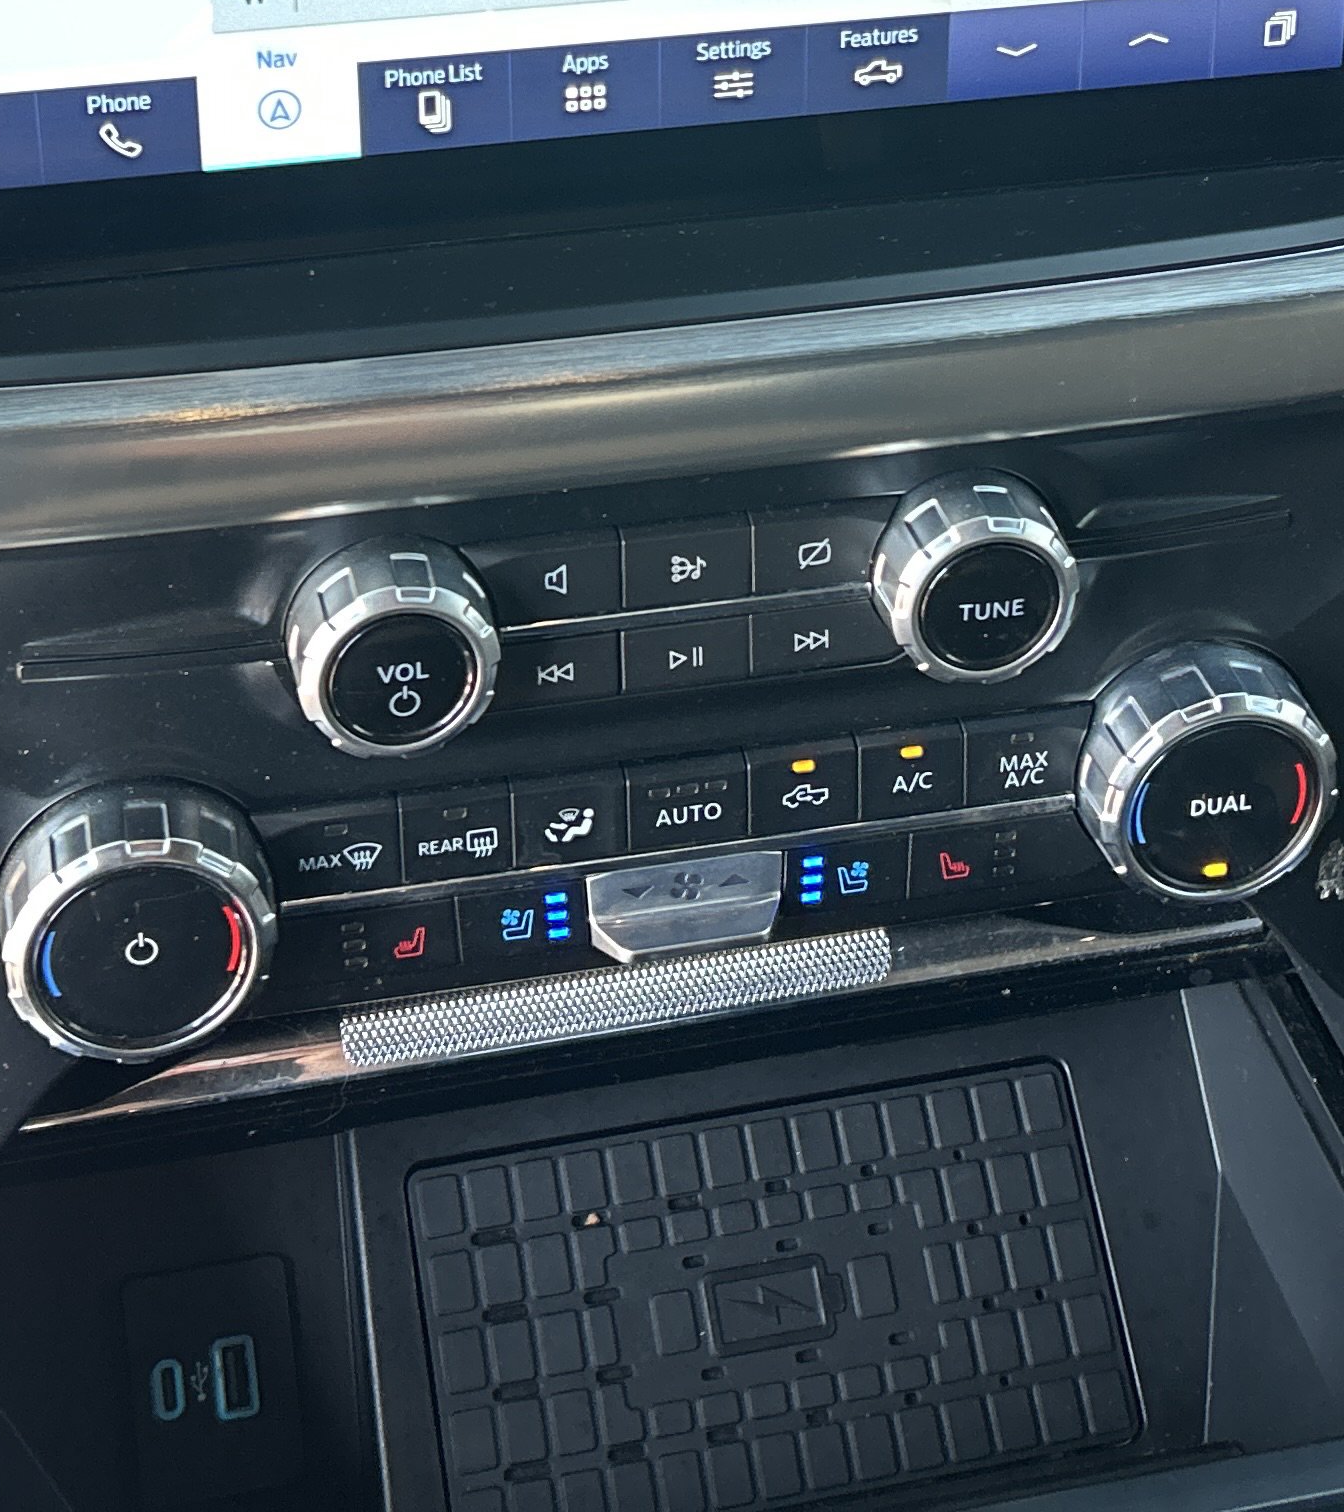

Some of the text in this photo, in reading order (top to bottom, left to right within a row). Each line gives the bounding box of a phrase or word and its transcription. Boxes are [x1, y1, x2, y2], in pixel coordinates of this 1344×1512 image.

[839, 26, 919, 49] Features
[256, 49, 299, 70] Nav
[695, 37, 772, 63] Settings
[384, 61, 484, 89] Phone List
[562, 53, 609, 75] Apps
[86, 93, 153, 115] Phone
[959, 598, 1026, 622] TUNE
[377, 661, 430, 684] VOL
[999, 750, 1049, 773] MAX
[892, 770, 934, 794] A/C
[1003, 766, 1045, 789] A/C
[655, 801, 723, 828] AUTO
[1189, 793, 1252, 818] DUAL
[418, 836, 465, 858] REAR
[298, 852, 342, 873] MAX
